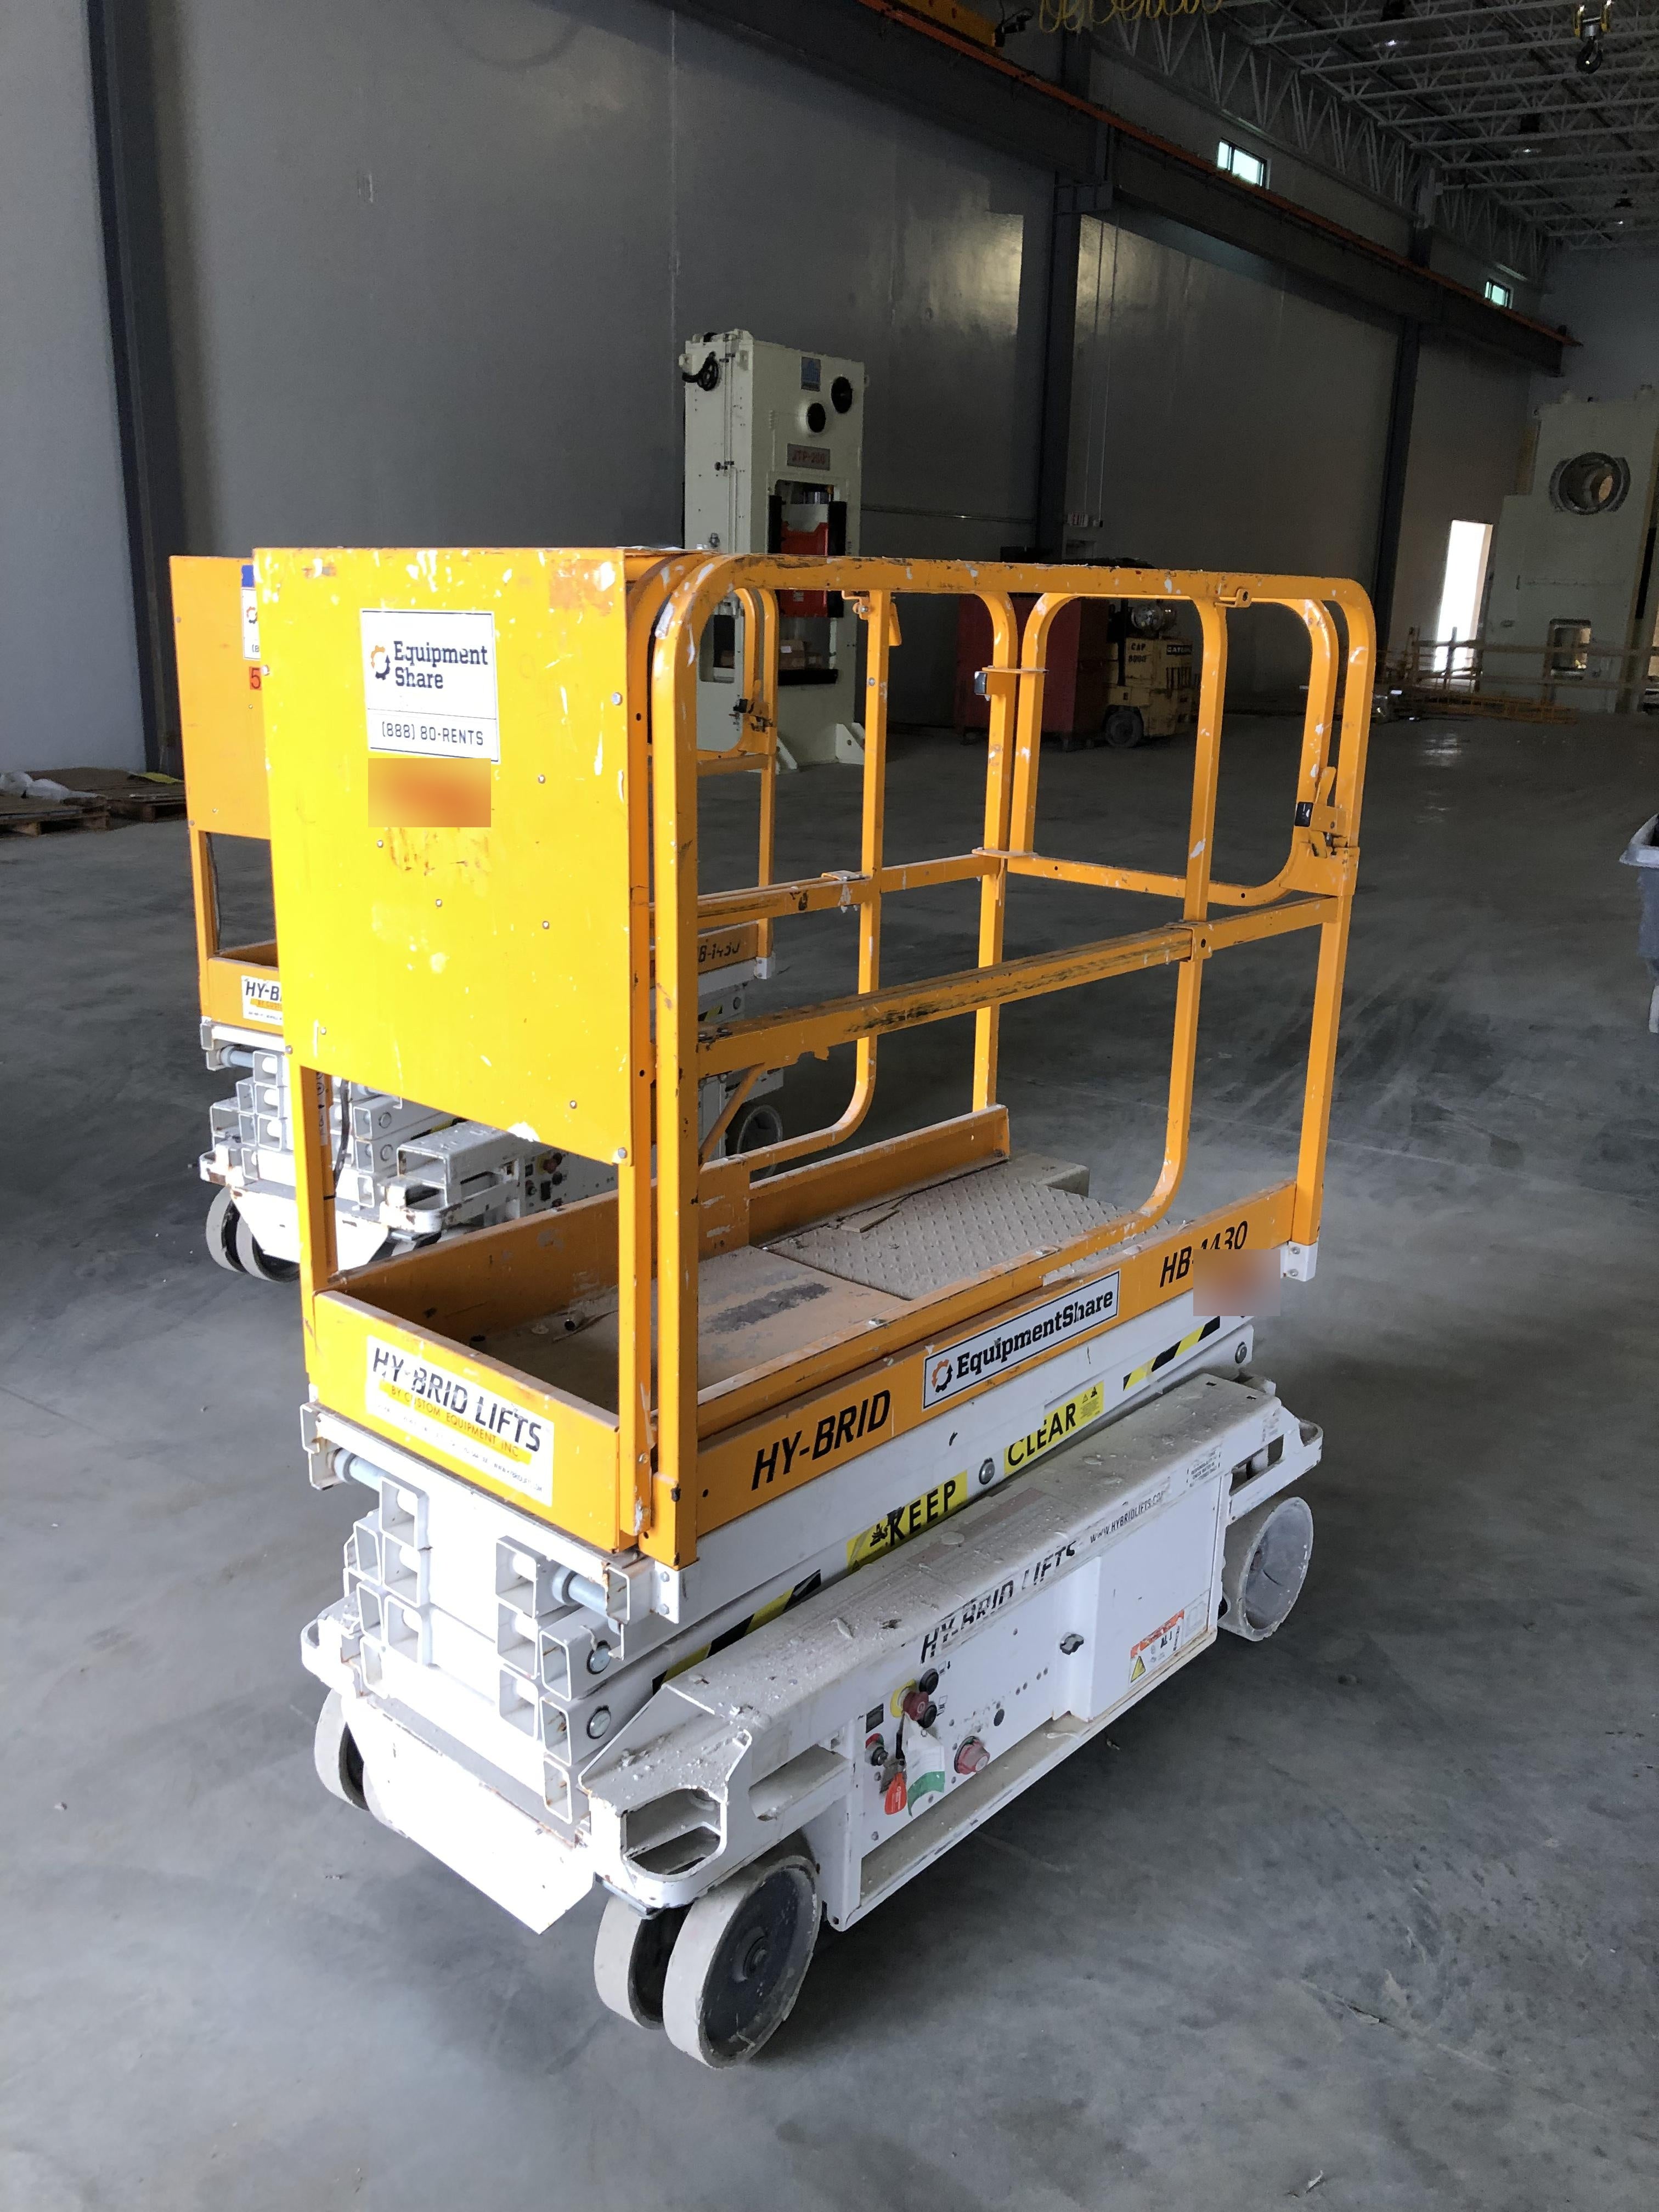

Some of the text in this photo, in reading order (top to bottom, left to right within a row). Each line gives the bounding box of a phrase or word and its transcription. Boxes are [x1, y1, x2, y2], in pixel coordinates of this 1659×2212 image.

[394, 641, 488, 668] Equipment
[395, 667, 443, 689] Share
[382, 721, 415, 740] (888)
[957, 1291, 1113, 1379] EquipmentShare
[391, 1386, 401, 1397] BY
[446, 1412, 496, 1444] EQUIPMENT
[476, 1396, 542, 1452] LIFTS
[751, 1389, 891, 1491] HY-BRID
[887, 1402, 1076, 1547] KEEP CLEAR
